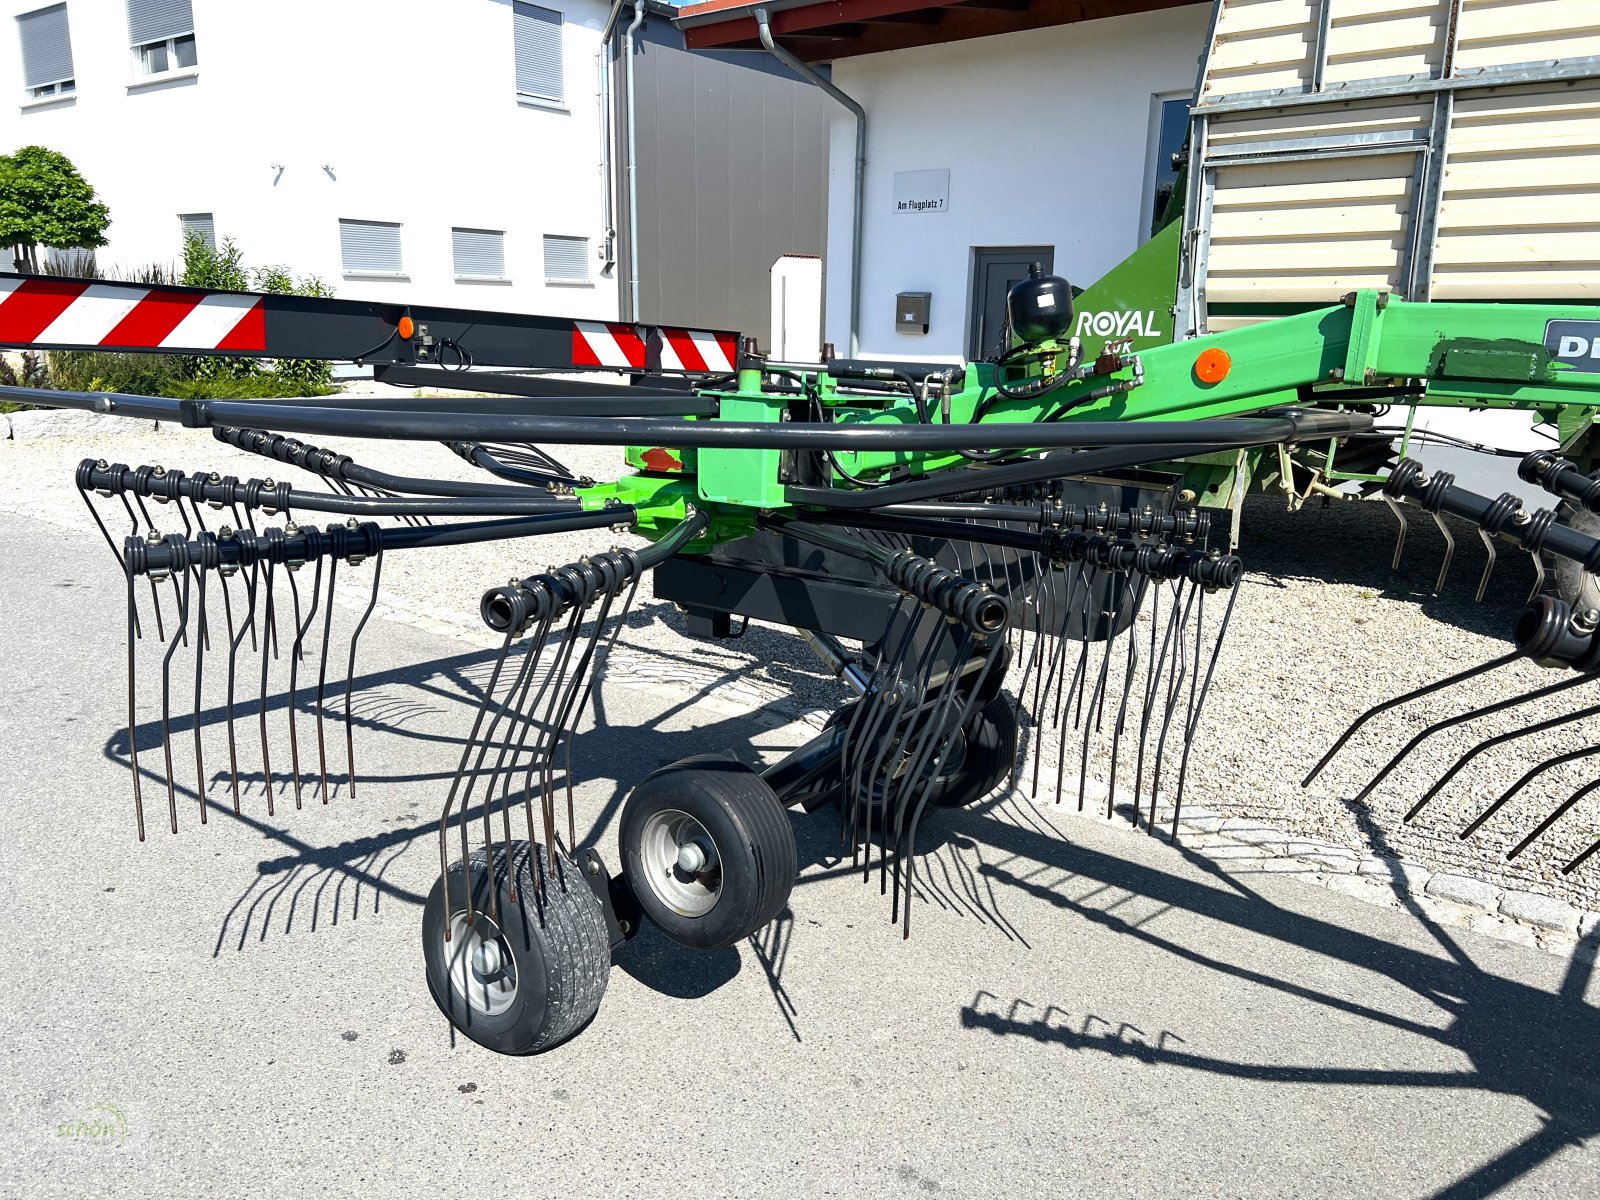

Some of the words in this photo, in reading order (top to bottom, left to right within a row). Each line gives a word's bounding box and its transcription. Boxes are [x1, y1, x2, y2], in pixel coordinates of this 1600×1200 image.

[897, 200, 908, 210] Am
[908, 199, 938, 211] Flugplatz
[939, 198, 944, 208] 7
[1075, 310, 1161, 337] ROYAL
